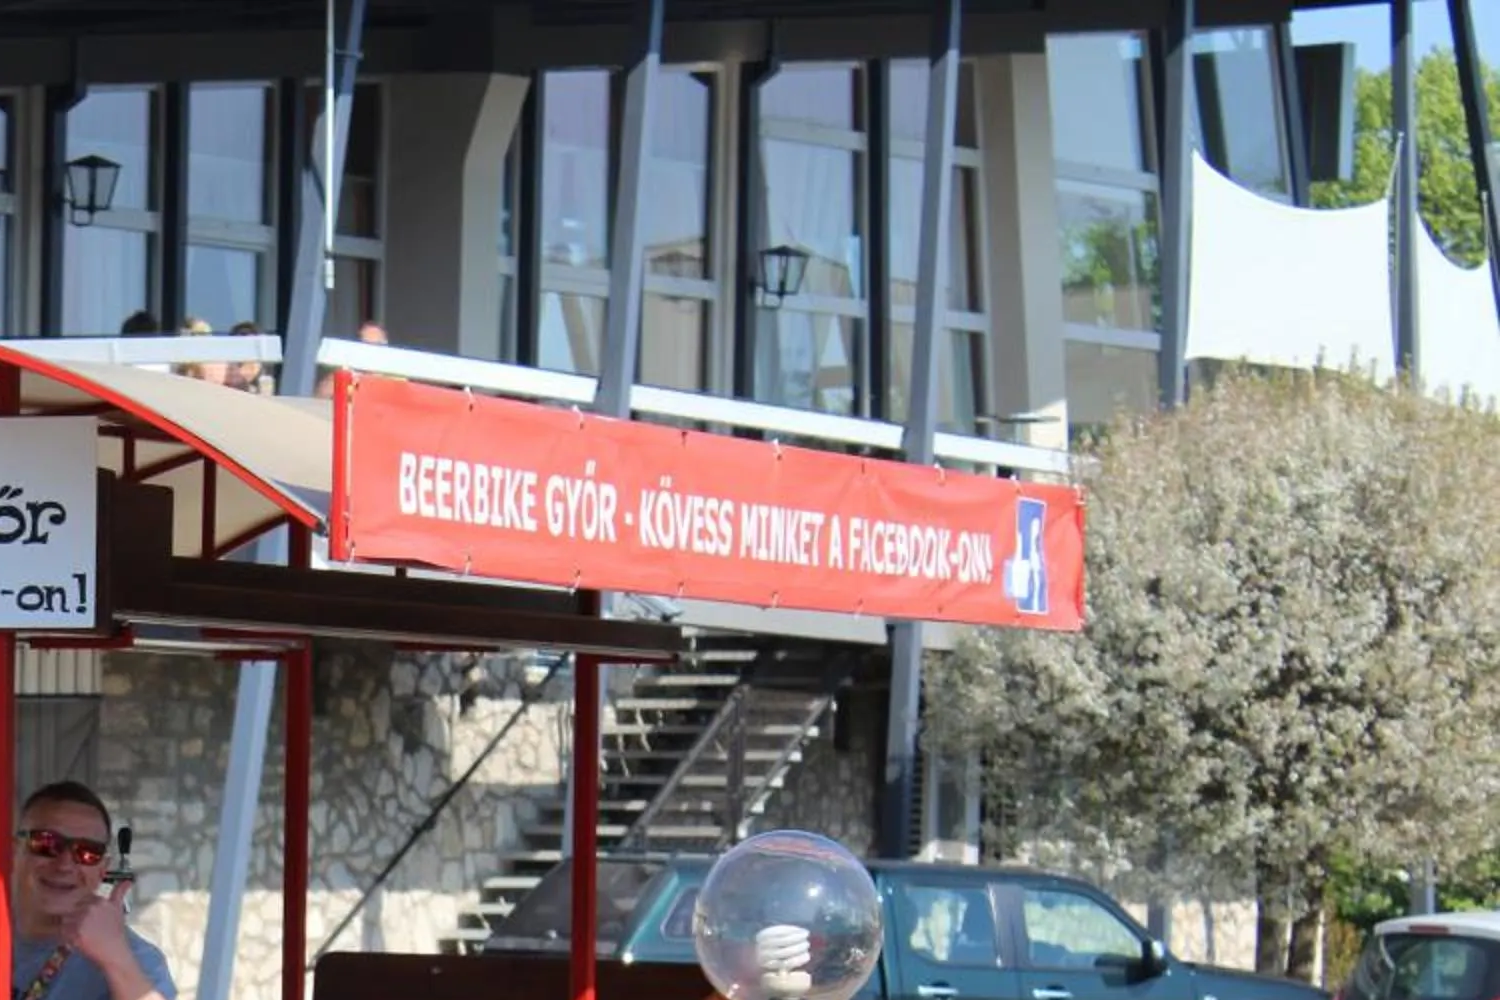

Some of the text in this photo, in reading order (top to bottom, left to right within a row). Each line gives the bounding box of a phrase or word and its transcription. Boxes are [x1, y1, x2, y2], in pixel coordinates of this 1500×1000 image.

[399, 451, 539, 532] BEERBIKE
[545, 460, 617, 543] GYŐR
[639, 475, 735, 556] KÖVESS
[739, 501, 825, 567] MINKET
[828, 513, 844, 570] A
